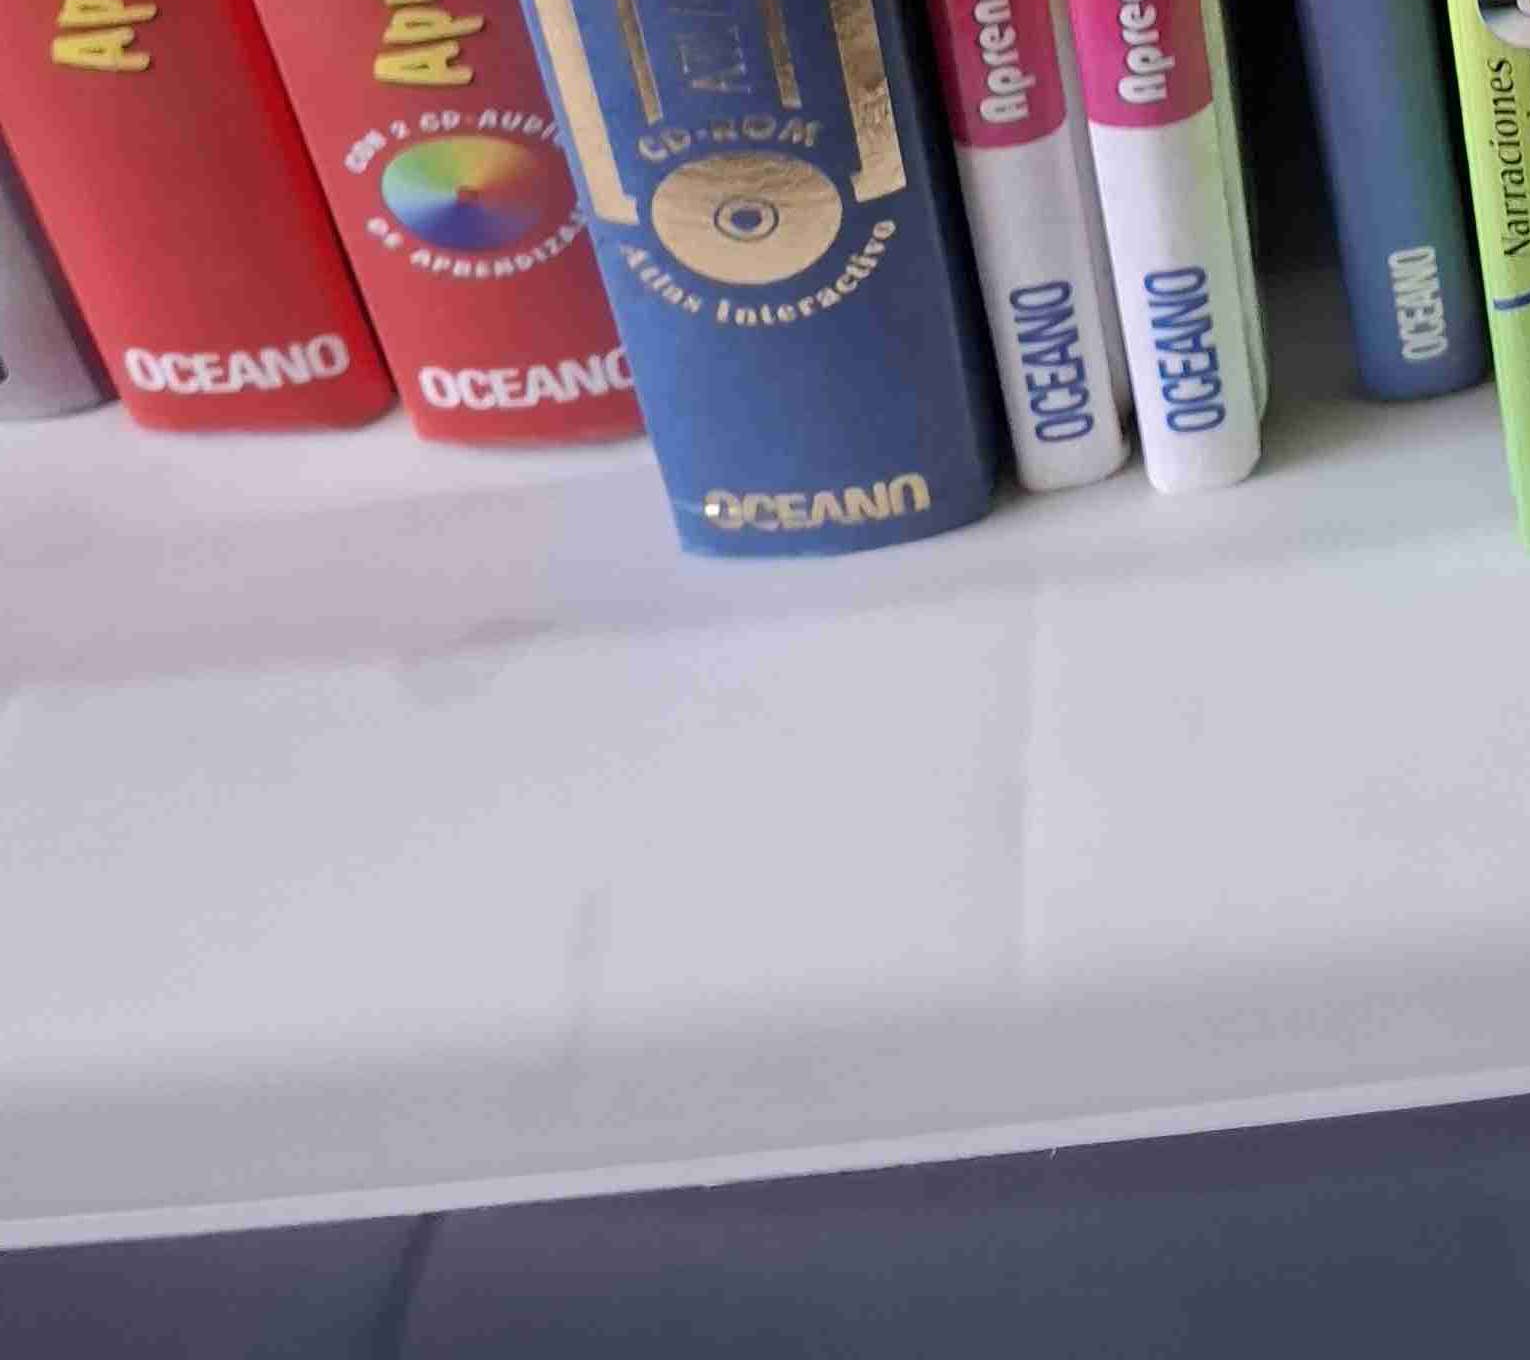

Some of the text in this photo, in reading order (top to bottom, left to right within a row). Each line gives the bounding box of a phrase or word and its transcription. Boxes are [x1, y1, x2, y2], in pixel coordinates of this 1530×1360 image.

[638, 112, 825, 161] CD-ROM
[619, 219, 897, 327] Atlas Interactivo
[1387, 246, 1448, 360] OCEANO
[123, 334, 349, 396] OCEANO
[1009, 279, 1093, 444] OCEANO
[1143, 266, 1226, 434] OCEANO
